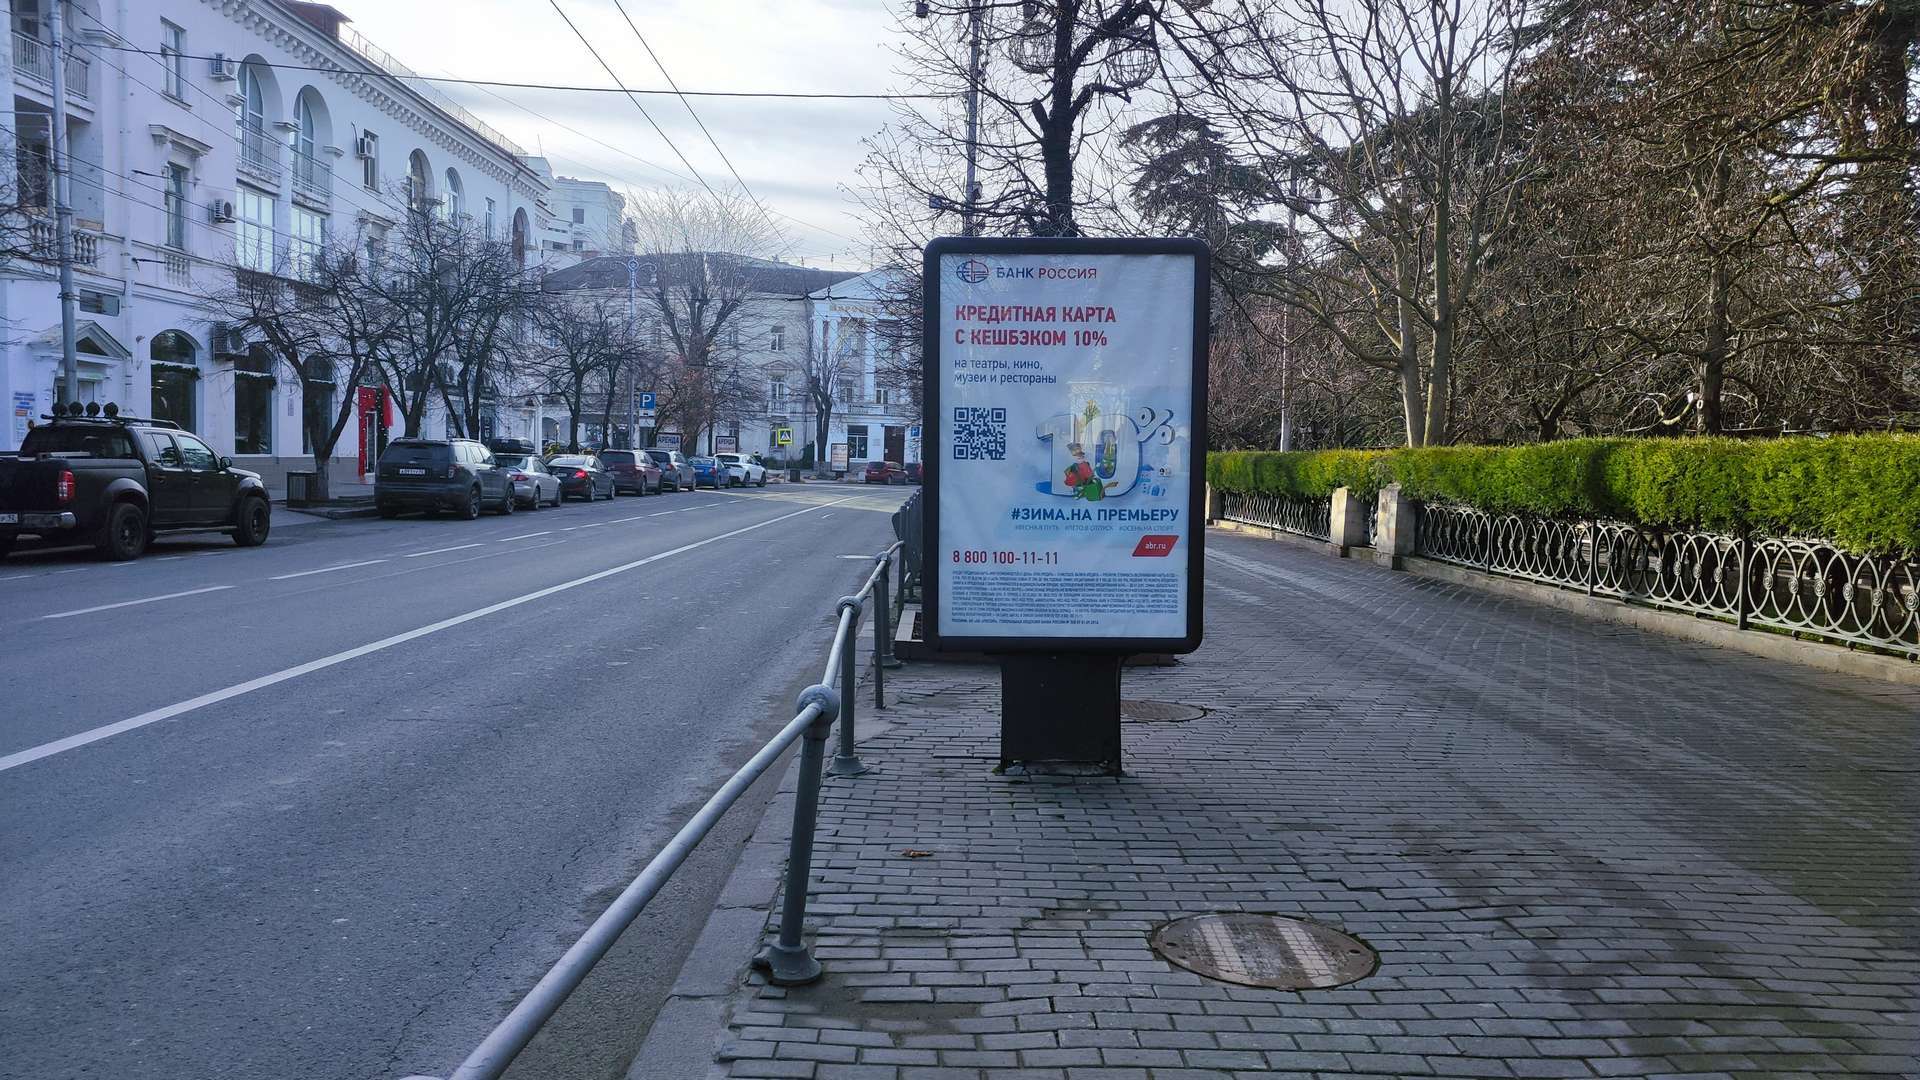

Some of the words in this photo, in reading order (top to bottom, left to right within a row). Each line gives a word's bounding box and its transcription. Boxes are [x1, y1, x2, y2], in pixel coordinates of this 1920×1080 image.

[996, 267, 1034, 279] БАНК
[1038, 268, 1097, 279] РОССИЯ
[955, 305, 1056, 324] КРЕДИТНАЯ
[1062, 306, 1116, 323] КАРТА
[955, 329, 965, 345] С
[970, 329, 1066, 346] КЕШБЭКОМ
[1074, 330, 1108, 346] 10%
[954, 360, 967, 369] на
[969, 360, 1010, 371] театры,
[1013, 360, 1043, 371] кино,
[954, 374, 989, 385] музеи
[991, 374, 998, 383] и
[1000, 374, 1057, 386] рестораны
[1011, 508, 1092, 521] #ЗИМА.НА
[1097, 509, 1179, 522] ПРЕМЬЕРУ
[1145, 541, 1167, 550] abr.ru
[952, 551, 960, 563] 8
[964, 551, 987, 564] 800
[992, 551, 1058, 565] 100-11-11
